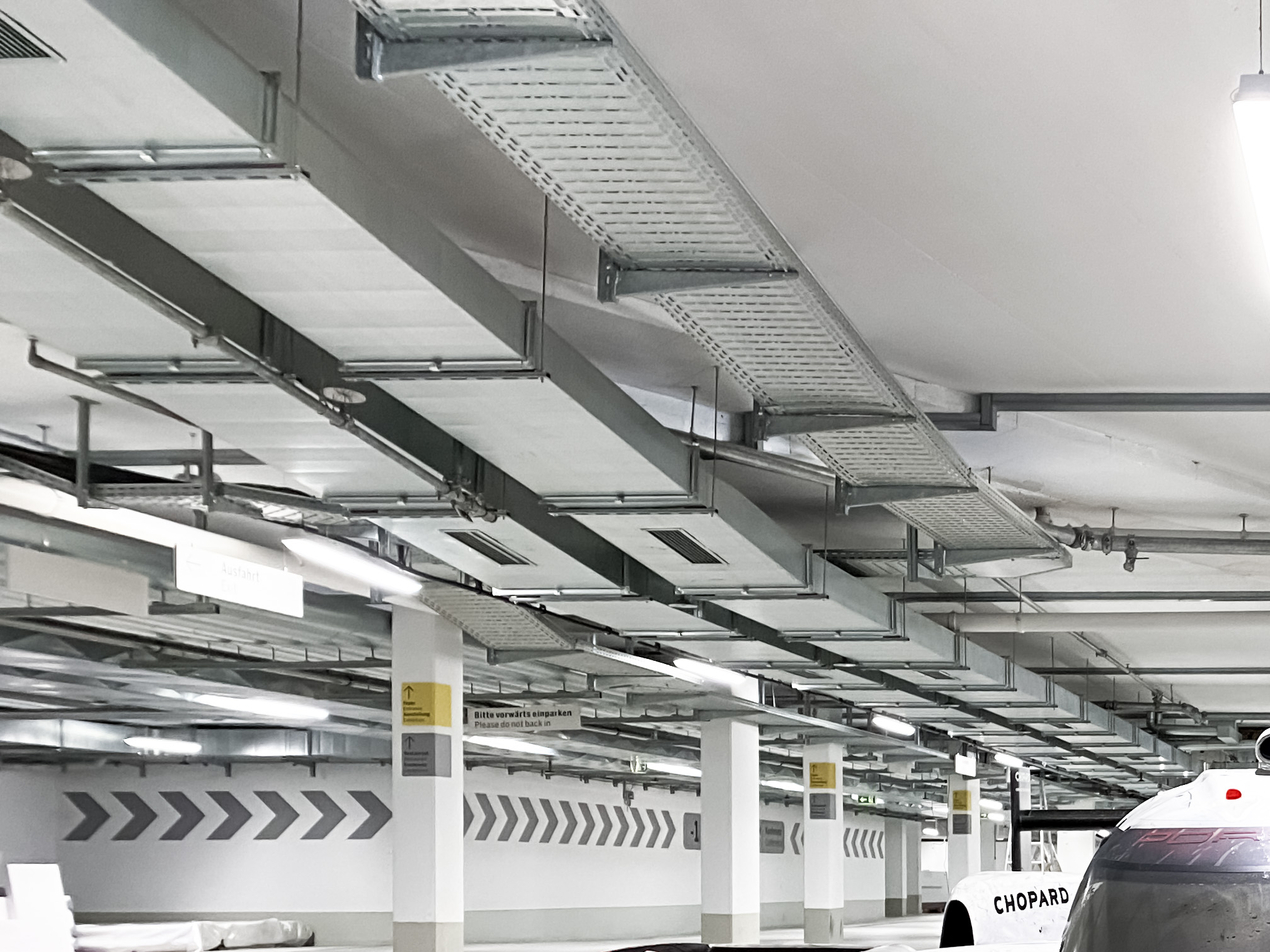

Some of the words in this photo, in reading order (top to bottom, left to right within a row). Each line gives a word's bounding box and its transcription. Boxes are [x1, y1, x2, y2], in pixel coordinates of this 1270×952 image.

[221, 562, 260, 582] Ausfahrt
[474, 711, 494, 719] Bitte
[496, 710, 531, 719] vorwärts
[532, 709, 572, 718] einparken
[474, 721, 500, 729] Please
[500, 720, 510, 728] do
[511, 720, 524, 728] not
[525, 720, 542, 728] back
[993, 887, 1069, 915] CHOPARD
